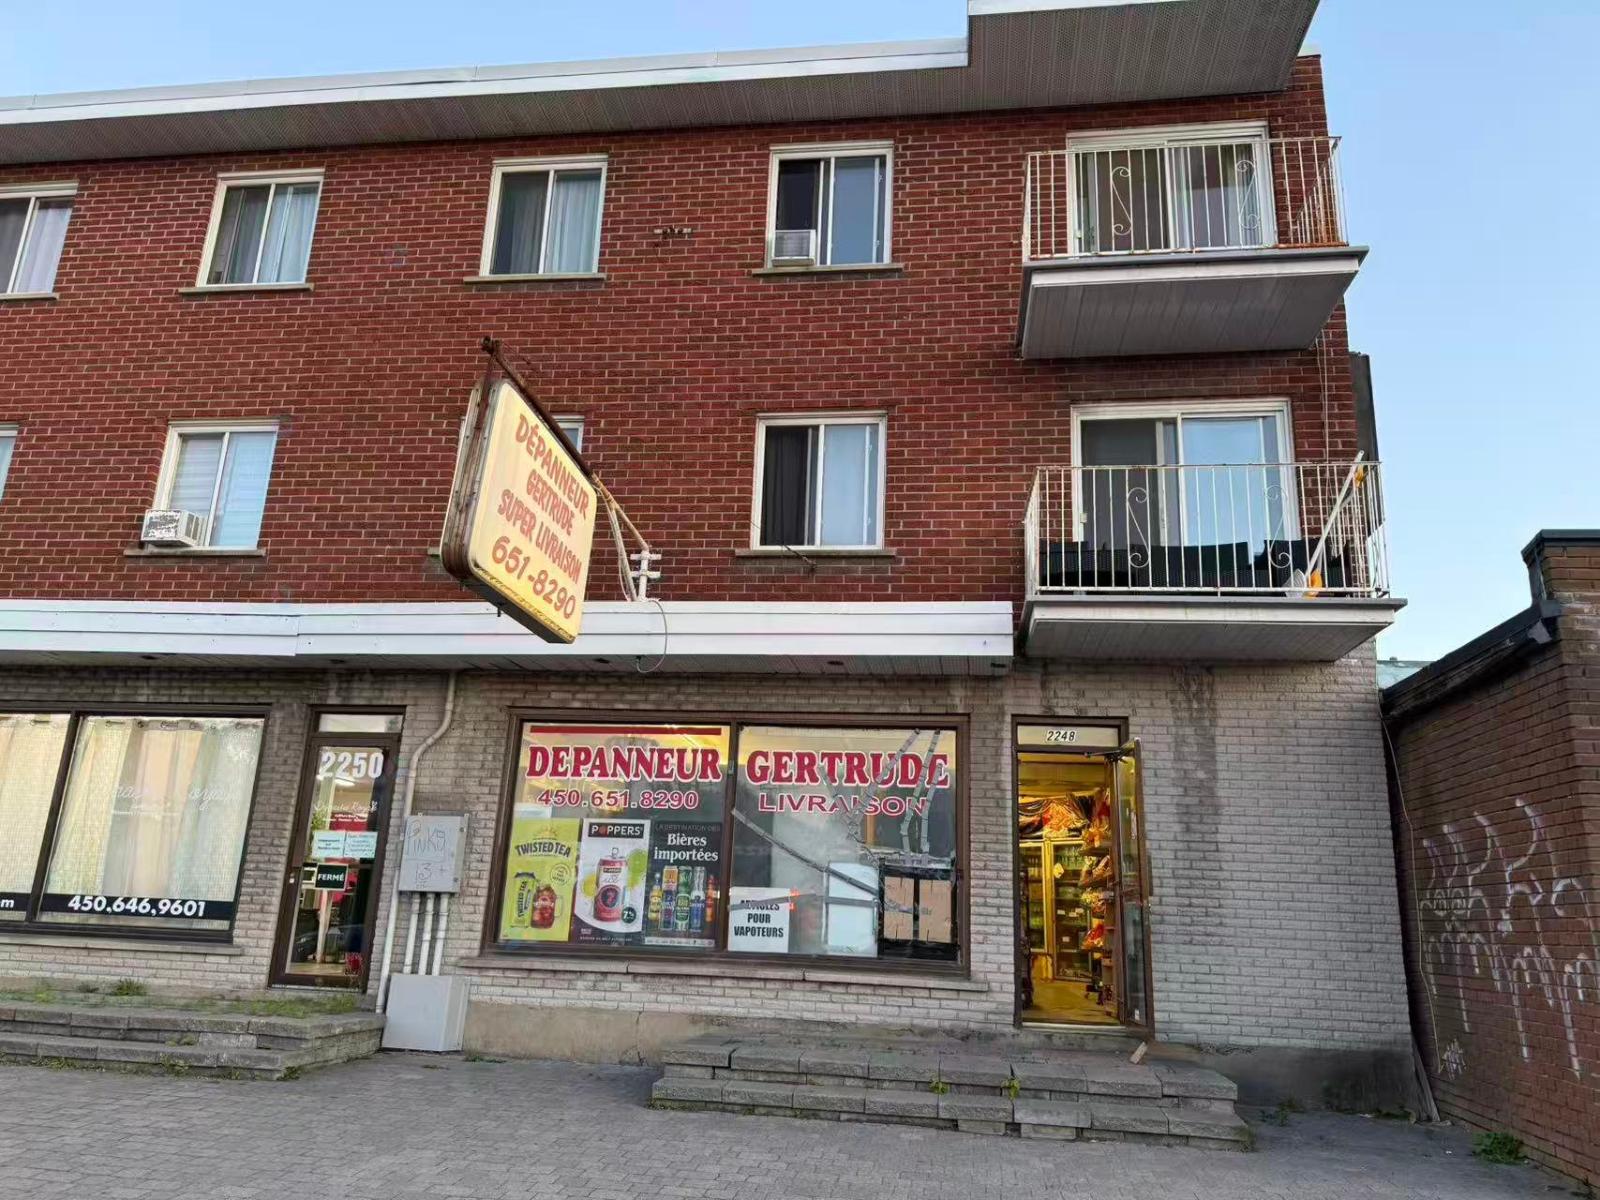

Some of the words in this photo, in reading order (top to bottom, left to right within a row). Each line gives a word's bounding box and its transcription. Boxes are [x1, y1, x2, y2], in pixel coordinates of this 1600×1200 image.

[516, 413, 589, 521] DÉPANNEUR
[526, 469, 576, 537] GERTRUDE
[498, 488, 537, 537] SUPER
[536, 521, 583, 584] LIVRAISON
[492, 535, 577, 619] 651-8290
[1047, 731, 1076, 741] 2248
[319, 751, 385, 779] 2250
[526, 744, 723, 783] DEPANNEUR
[746, 750, 950, 789] GERTRUDE
[537, 789, 700, 809] 450.651.8290
[515, 842, 554, 856] TWISTED
[554, 843, 572, 858] TEA
[667, 833, 707, 847] Bières
[654, 847, 719, 862] importées
[317, 873, 345, 881] FERMÉ
[747, 913, 771, 924] POUR
[733, 926, 784, 938] VAPOTEURS
